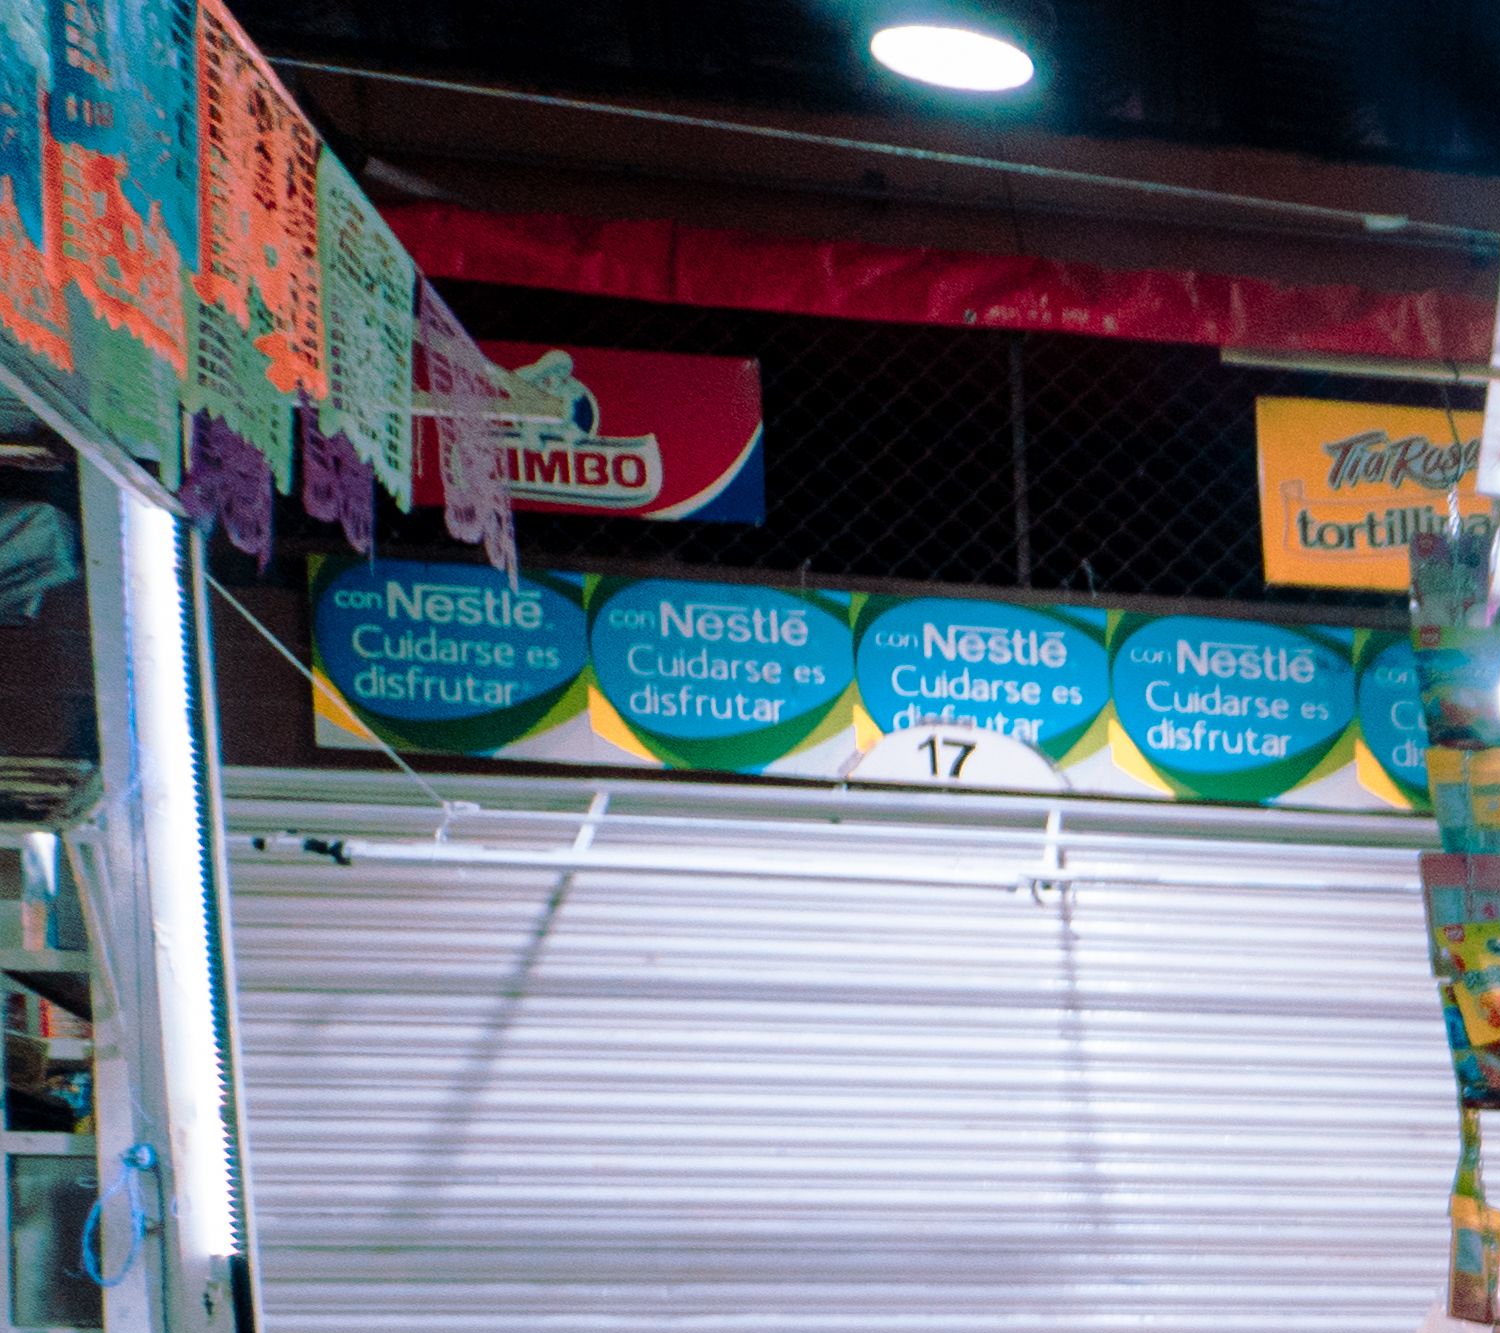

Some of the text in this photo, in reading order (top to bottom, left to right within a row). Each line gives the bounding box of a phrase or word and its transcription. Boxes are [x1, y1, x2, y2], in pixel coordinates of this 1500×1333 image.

[495, 448, 649, 488] IMBO
[333, 587, 384, 610] con
[608, 608, 656, 630] con
[351, 625, 561, 670] Cuidarse es
[874, 630, 919, 651] con
[1130, 645, 1172, 667] con
[626, 644, 826, 687] Cuidarse es
[890, 663, 1083, 707] Cuidarse es
[353, 670, 516, 708] disfrutar
[628, 688, 786, 726] disfrutar
[1144, 679, 1330, 722] Cuidarse es
[917, 734, 978, 782] 17
[1145, 717, 1292, 759] disfrutar
